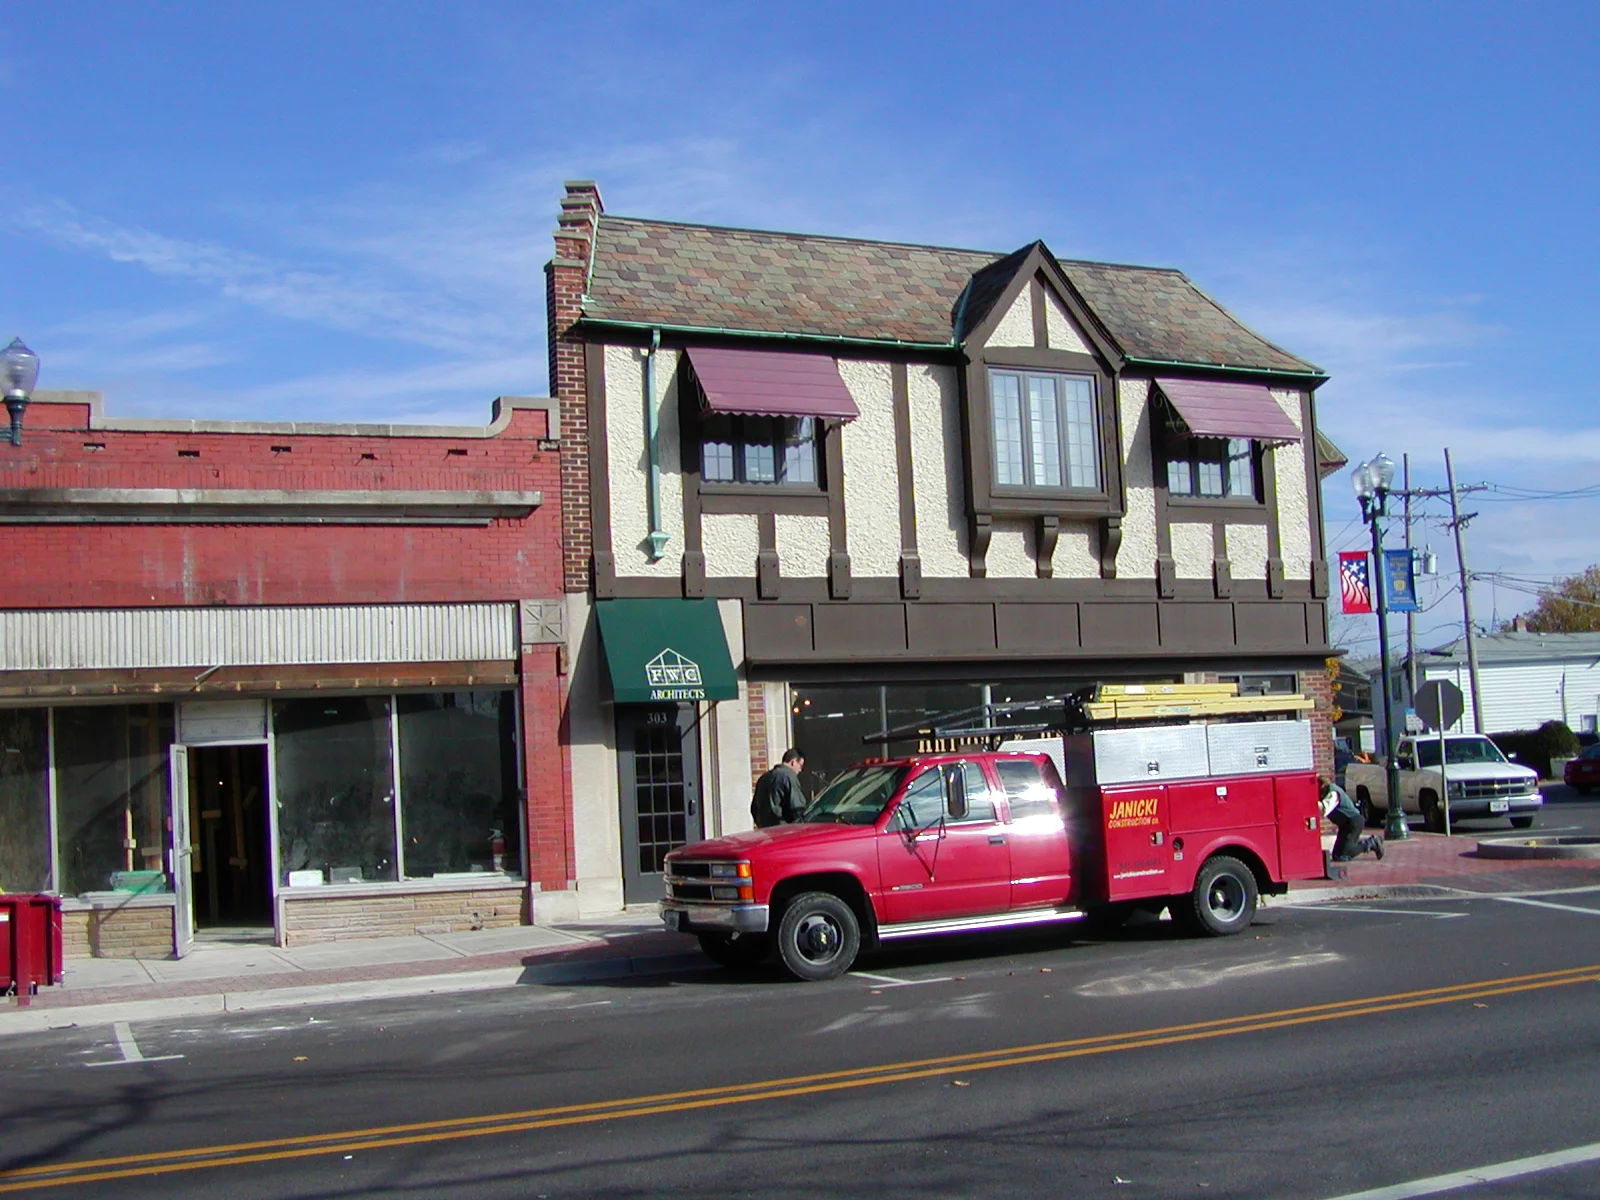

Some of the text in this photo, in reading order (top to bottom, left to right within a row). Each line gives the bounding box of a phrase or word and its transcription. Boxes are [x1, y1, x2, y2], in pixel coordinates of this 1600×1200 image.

[650, 688, 705, 700] ARCHITECTS
[647, 712, 667, 724] 303
[1109, 798, 1158, 819] JANICKI
